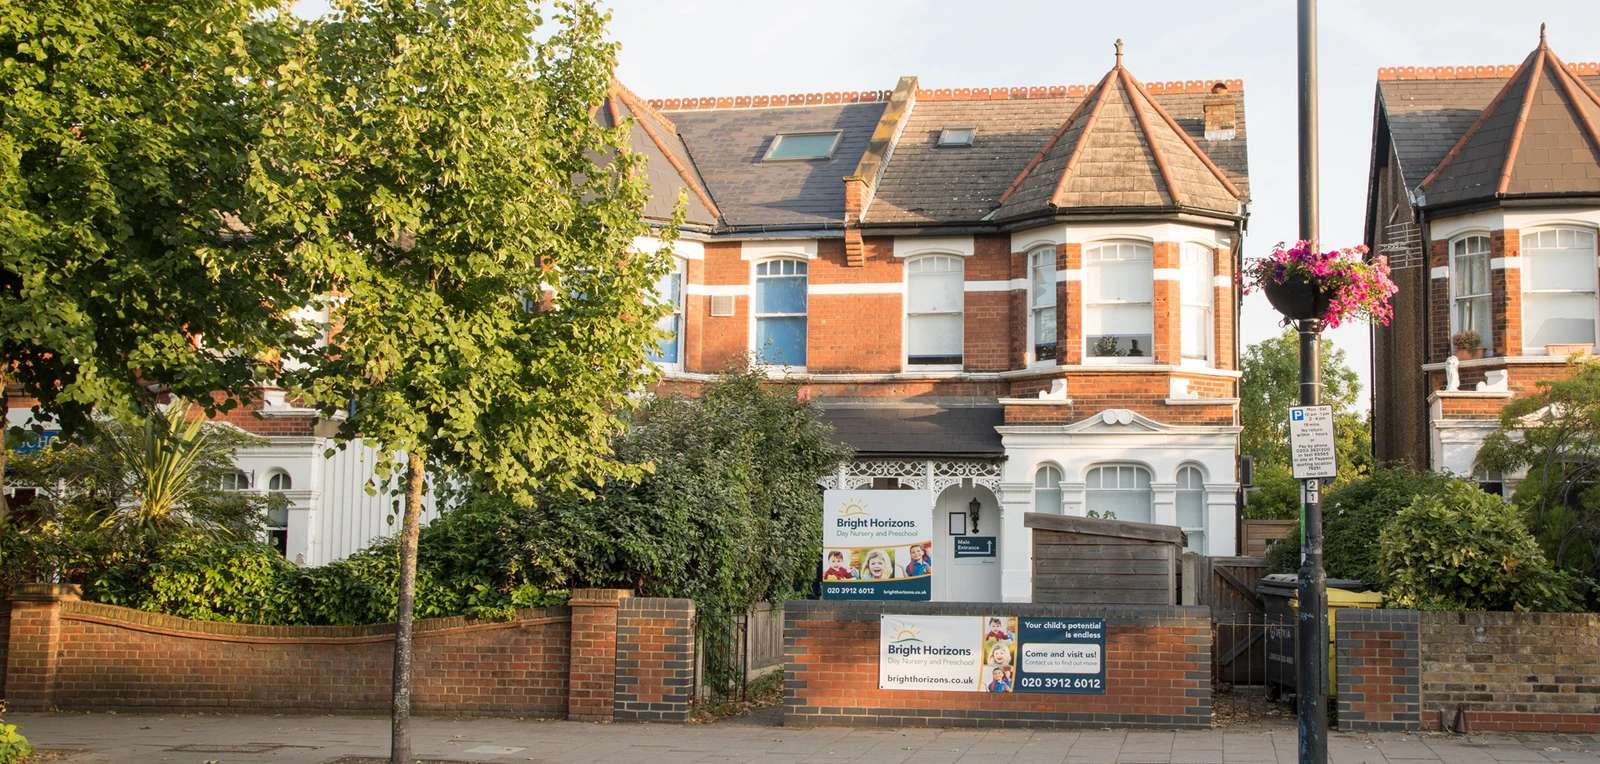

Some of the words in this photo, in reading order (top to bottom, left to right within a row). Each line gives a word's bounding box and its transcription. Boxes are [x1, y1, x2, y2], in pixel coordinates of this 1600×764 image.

[1294, 410, 1302, 420] P
[1310, 480, 1316, 488] 2
[837, 518, 868, 529] Bright
[870, 518, 915, 528] Horizons
[1068, 622, 1102, 630] potential
[888, 644, 920, 657] Bright
[924, 646, 972, 656] Horizons
[1050, 650, 1064, 658] and
[1086, 650, 1097, 658] us!
[888, 674, 974, 684] brighthorizons.co.uk
[1022, 678, 1042, 687] 020
[1045, 678, 1071, 688] 3912
[1074, 678, 1100, 688] 6012
